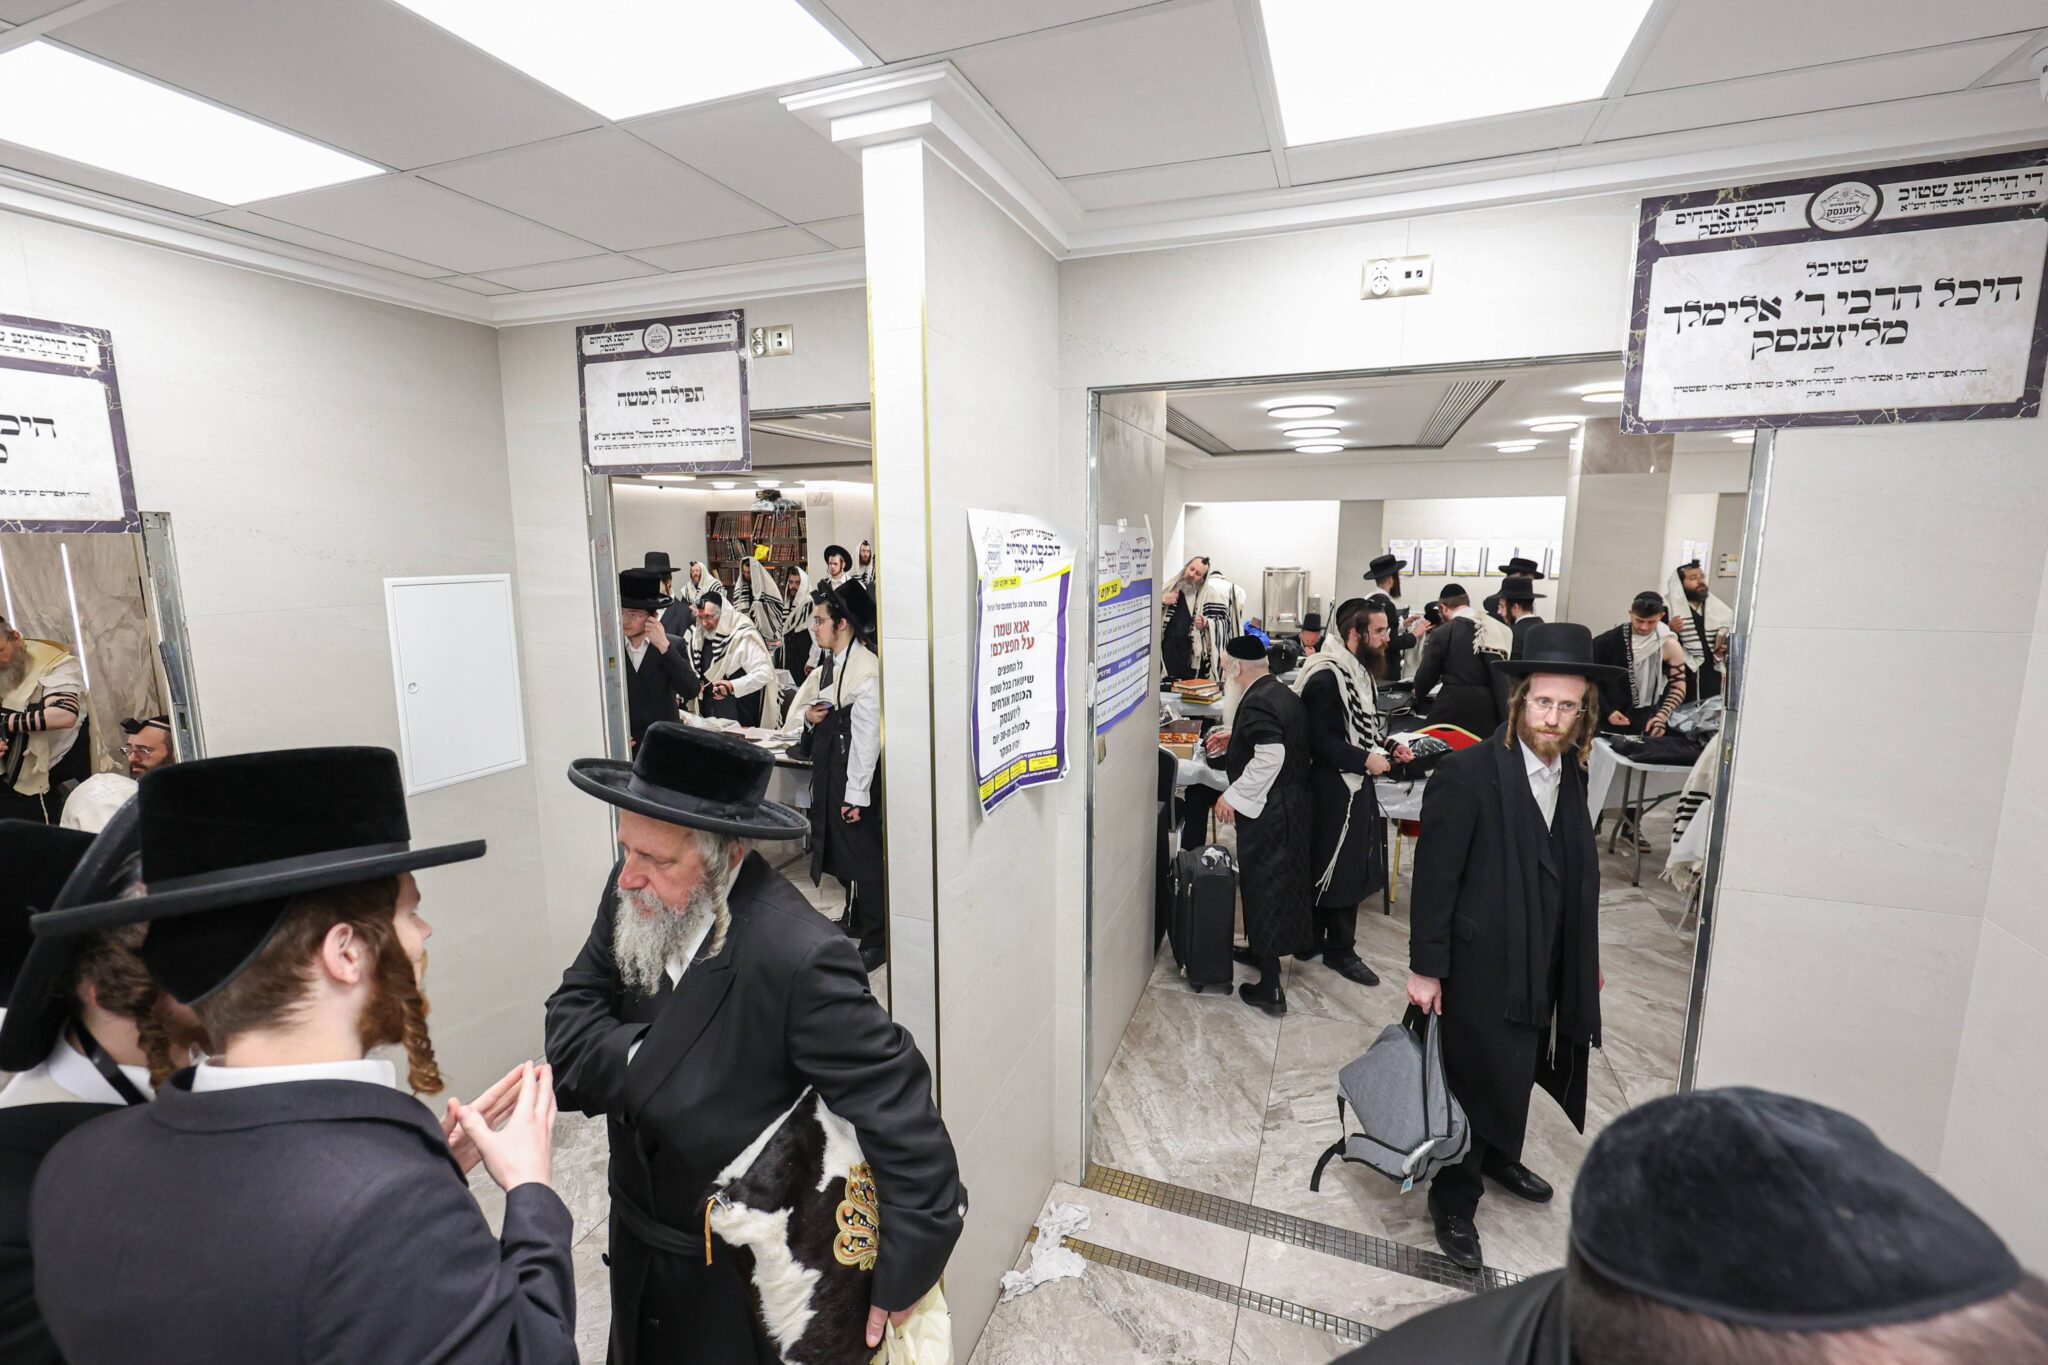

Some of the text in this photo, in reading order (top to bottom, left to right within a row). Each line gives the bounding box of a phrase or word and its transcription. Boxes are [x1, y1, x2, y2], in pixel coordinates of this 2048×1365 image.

[1898, 172, 2044, 202] די הייליגע שטוב
[1826, 204, 1861, 218] ליזענסק
[1930, 196, 1964, 209] אלימלך
[1675, 200, 1786, 226] הכנסת אורחים
[1698, 218, 1759, 240] ליזענסק
[1806, 258, 1869, 278] שטיבל
[1664, 275, 2023, 334] היכל הרבי ר' אלימלך
[72, 341, 88, 354] די
[590, 334, 612, 344] אורחים
[1751, 318, 1909, 361] מליזענסק
[618, 386, 704, 407] תפילה למשה
[0, 414, 56, 438] היכ
[1030, 544, 1060, 556] הכנסת
[994, 620, 1030, 638] אנא שמרו
[990, 634, 1034, 658] על חפציכם!
[998, 660, 1023, 676] כל החפצים
[1002, 680, 1011, 692] בכל
[992, 690, 1032, 712] הכנסת אורחים
[1000, 705, 1020, 728] ליזענסק
[1011, 720, 1030, 736] למעלה
[992, 734, 1000, 745] יום
